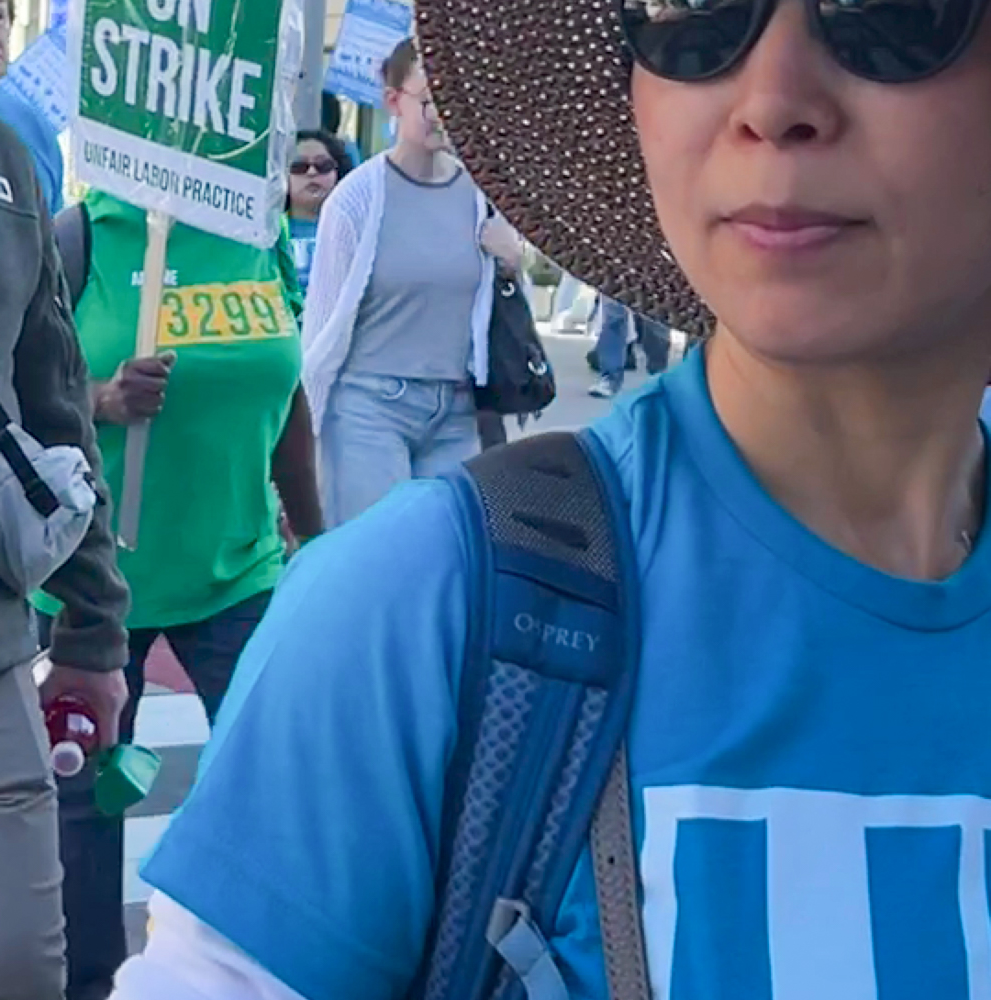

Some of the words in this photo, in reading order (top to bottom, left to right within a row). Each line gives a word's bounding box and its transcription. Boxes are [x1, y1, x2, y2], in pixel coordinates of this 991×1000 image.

[90, 18, 262, 143] STRIKE
[84, 140, 130, 177] UNFAIR
[134, 158, 180, 195] LABOR
[182, 176, 255, 220] PRACTICE
[162, 291, 280, 336] 3299
